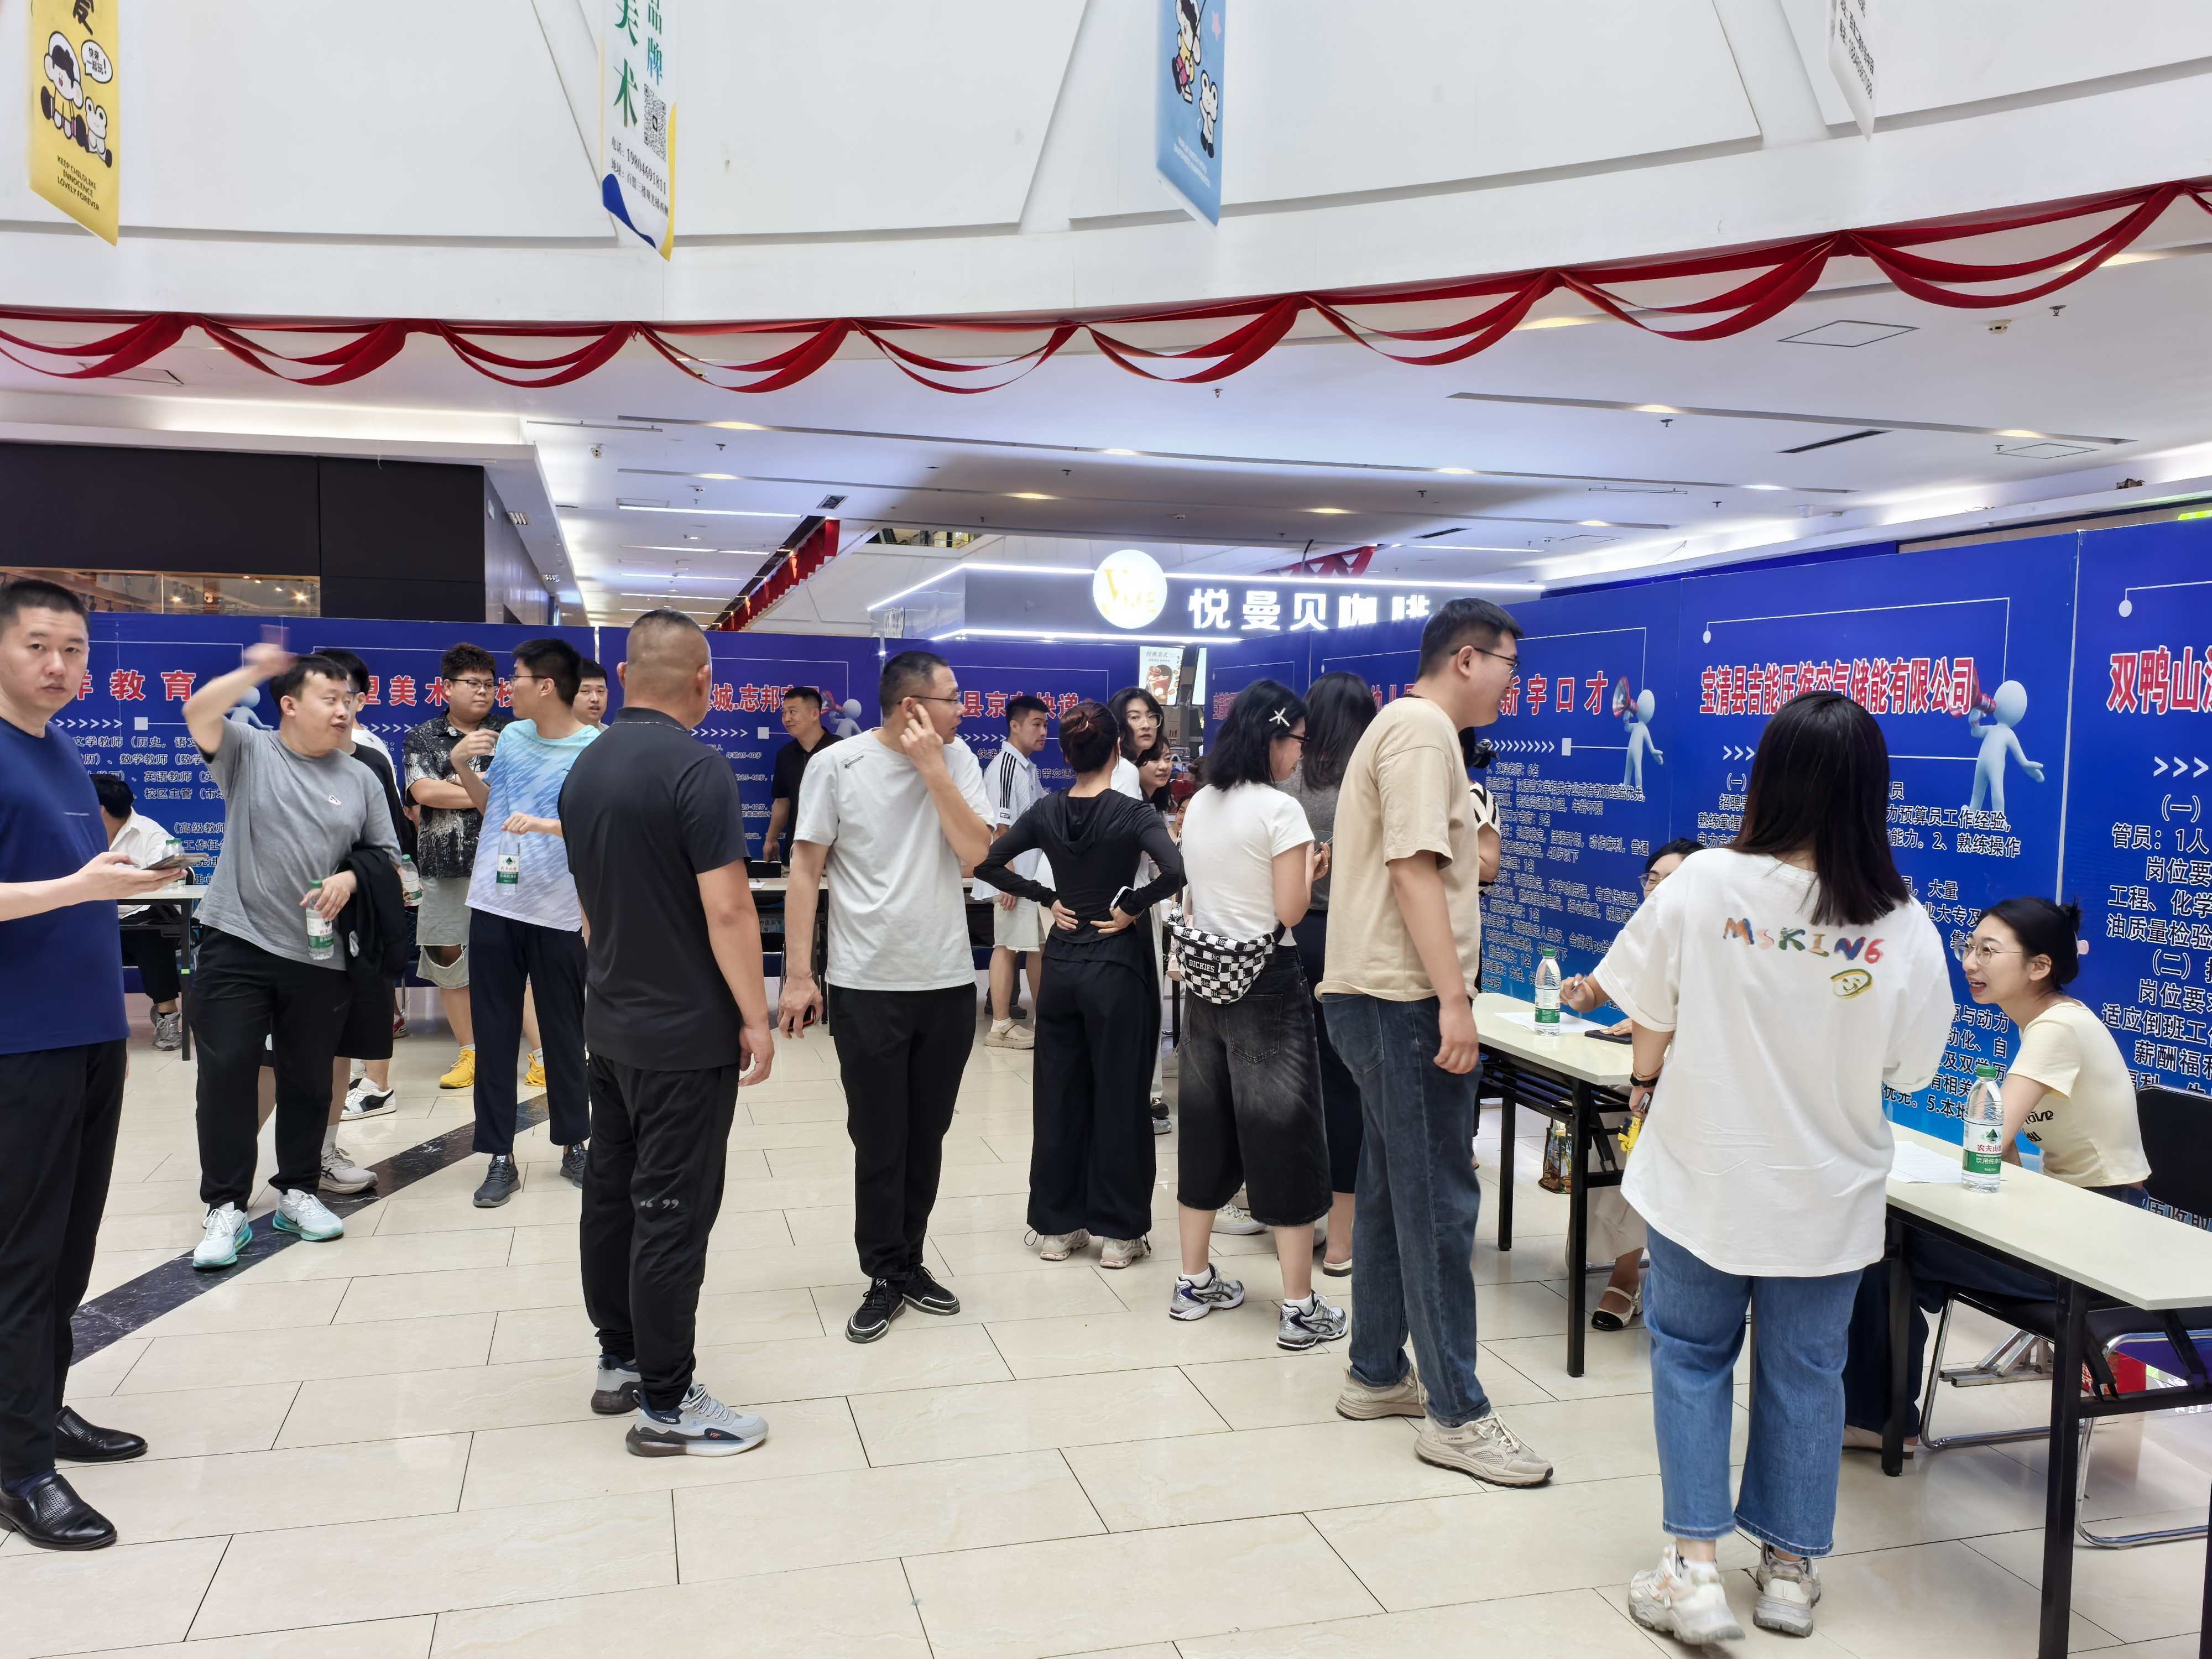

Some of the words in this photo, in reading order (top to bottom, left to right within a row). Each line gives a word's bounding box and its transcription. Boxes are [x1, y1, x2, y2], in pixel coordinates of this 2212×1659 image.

[963, 691, 1079, 719] 县京快递
[977, 748, 1001, 759] 快递
[1888, 781, 1904, 800] 员
[184, 839, 223, 850] 工作任
[1888, 827, 2021, 858] 能力。2、熟练操作
[2146, 856, 2212, 888] 岗位要
[2107, 885, 2212, 919] 工程、化学
[2106, 913, 2212, 952] 油质量检验
[1189, 959, 1215, 974] DICKIES
[2101, 1003, 2212, 1046] 适应倒班工
